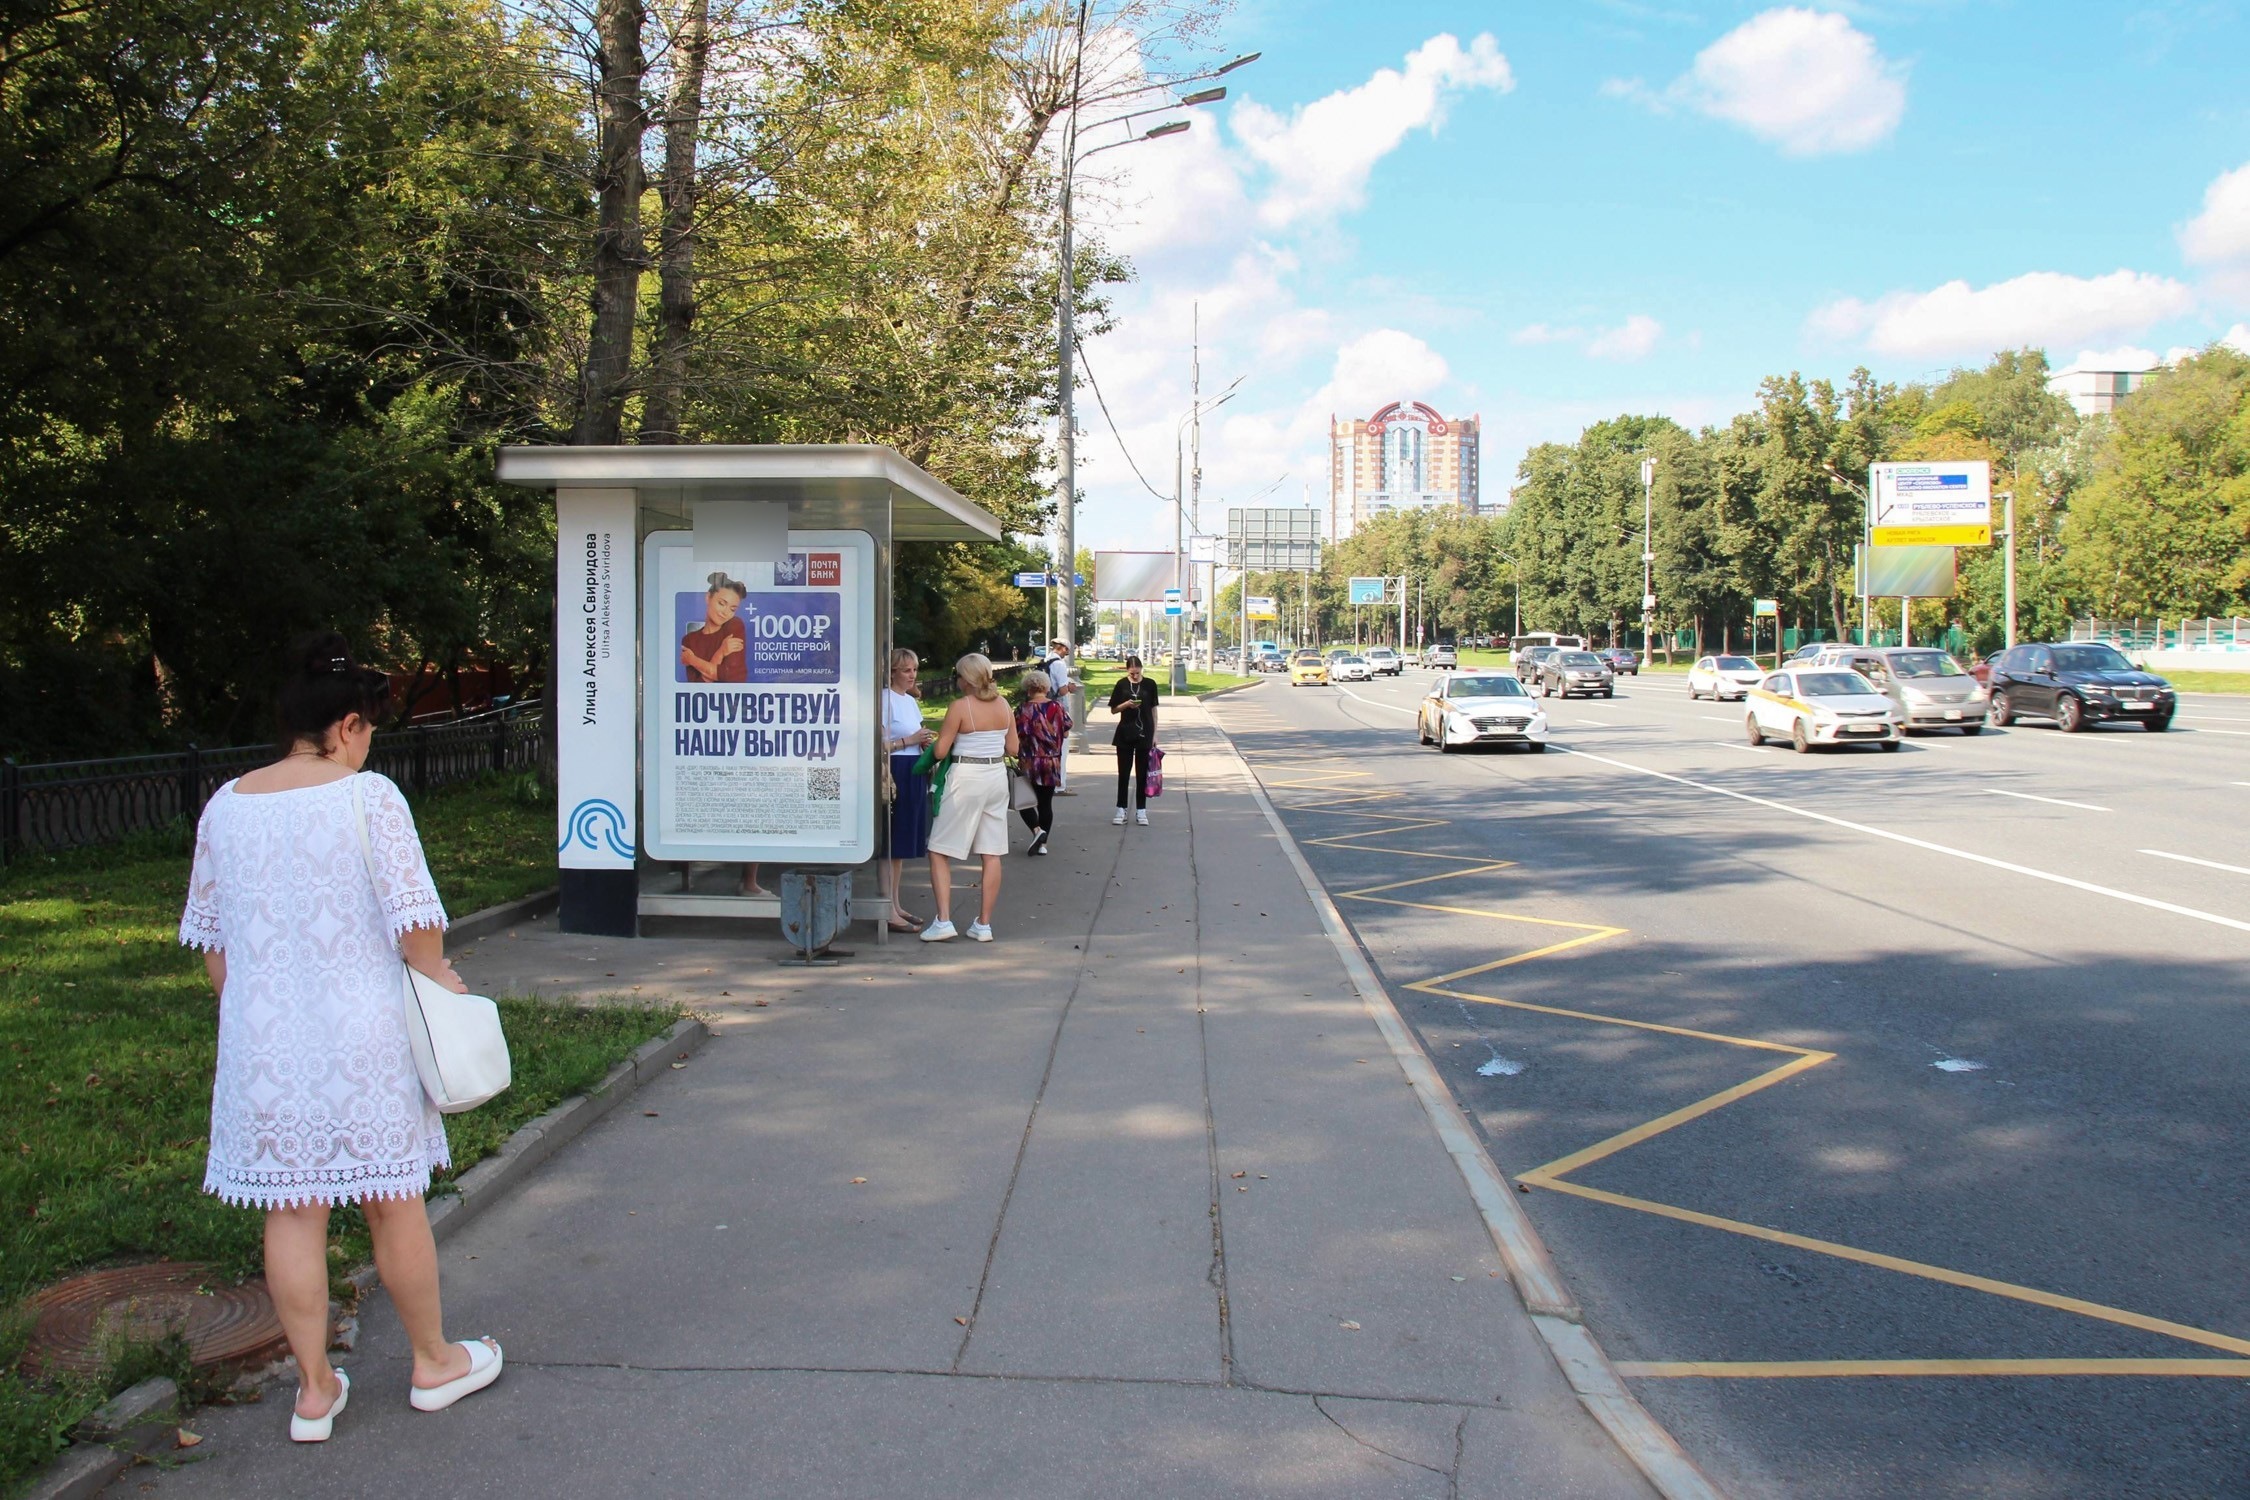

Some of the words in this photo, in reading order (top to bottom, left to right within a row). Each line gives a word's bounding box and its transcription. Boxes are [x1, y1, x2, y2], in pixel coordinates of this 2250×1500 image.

[583, 533, 599, 613] Свиридова
[602, 533, 611, 580] Sviridova
[811, 560, 838, 569] ПОЧТА
[811, 570, 835, 579] БАНК
[602, 583, 612, 626] Alekseya
[749, 614, 831, 639] 1000₽
[583, 617, 597, 677] Алексея
[602, 629, 611, 659] Ulitsa
[754, 642, 788, 651] ПОСЛЕ
[790, 640, 831, 651] ПЕРВОЙ
[754, 652, 801, 661] ПОКУПКИ
[583, 681, 598, 725] Улица
[675, 688, 840, 724] ПОЧУВСТВУЙ
[675, 728, 740, 757] НАШУ
[744, 729, 840, 761] ВЫГОДУ
